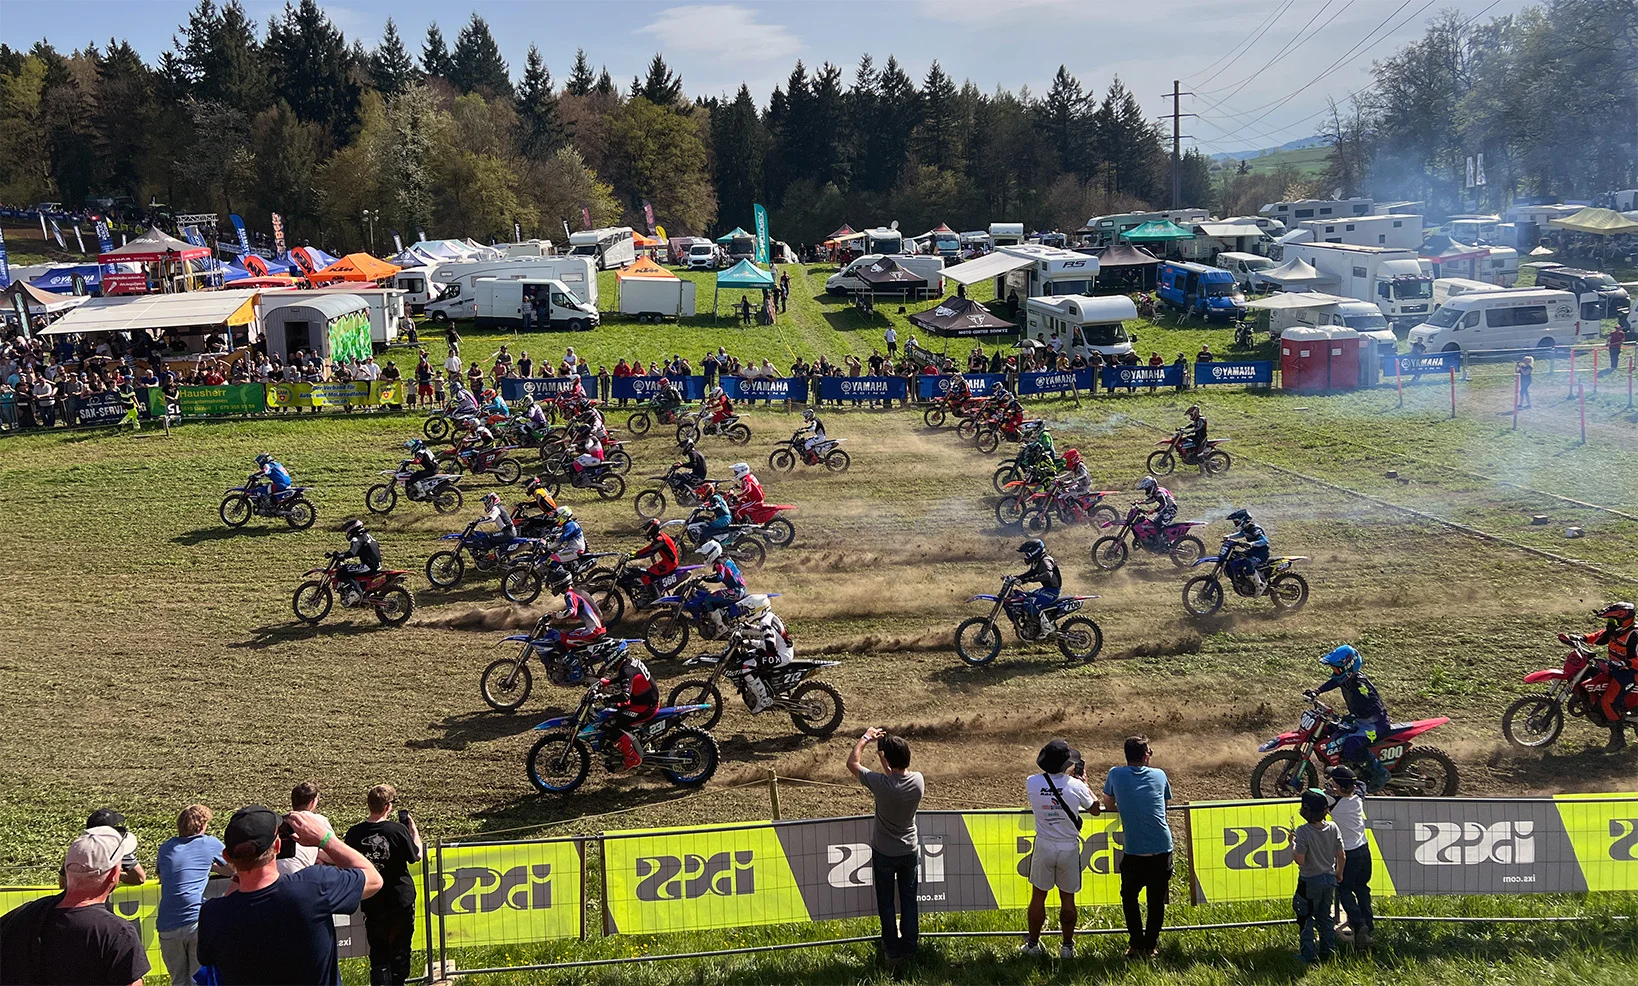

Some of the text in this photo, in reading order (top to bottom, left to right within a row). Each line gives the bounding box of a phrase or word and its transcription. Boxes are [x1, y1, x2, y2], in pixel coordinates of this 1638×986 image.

[1062, 260, 1087, 269] RS
[60, 274, 95, 283] YAHA
[1410, 357, 1443, 367] YAMAHA
[1131, 369, 1165, 379] YAMAHA
[1222, 366, 1256, 376] YAMAHA
[950, 379, 986, 389] YAHA
[1045, 373, 1077, 385] YAMAHA
[645, 380, 684, 391] YAHA
[752, 381, 789, 392] YAMAHA
[852, 381, 888, 391] YAMAHA
[180, 388, 227, 398] Hausherr
[661, 574, 677, 588] 566
[762, 656, 782, 665] FOX
[649, 720, 666, 735] 231
[1379, 745, 1403, 762] 300
